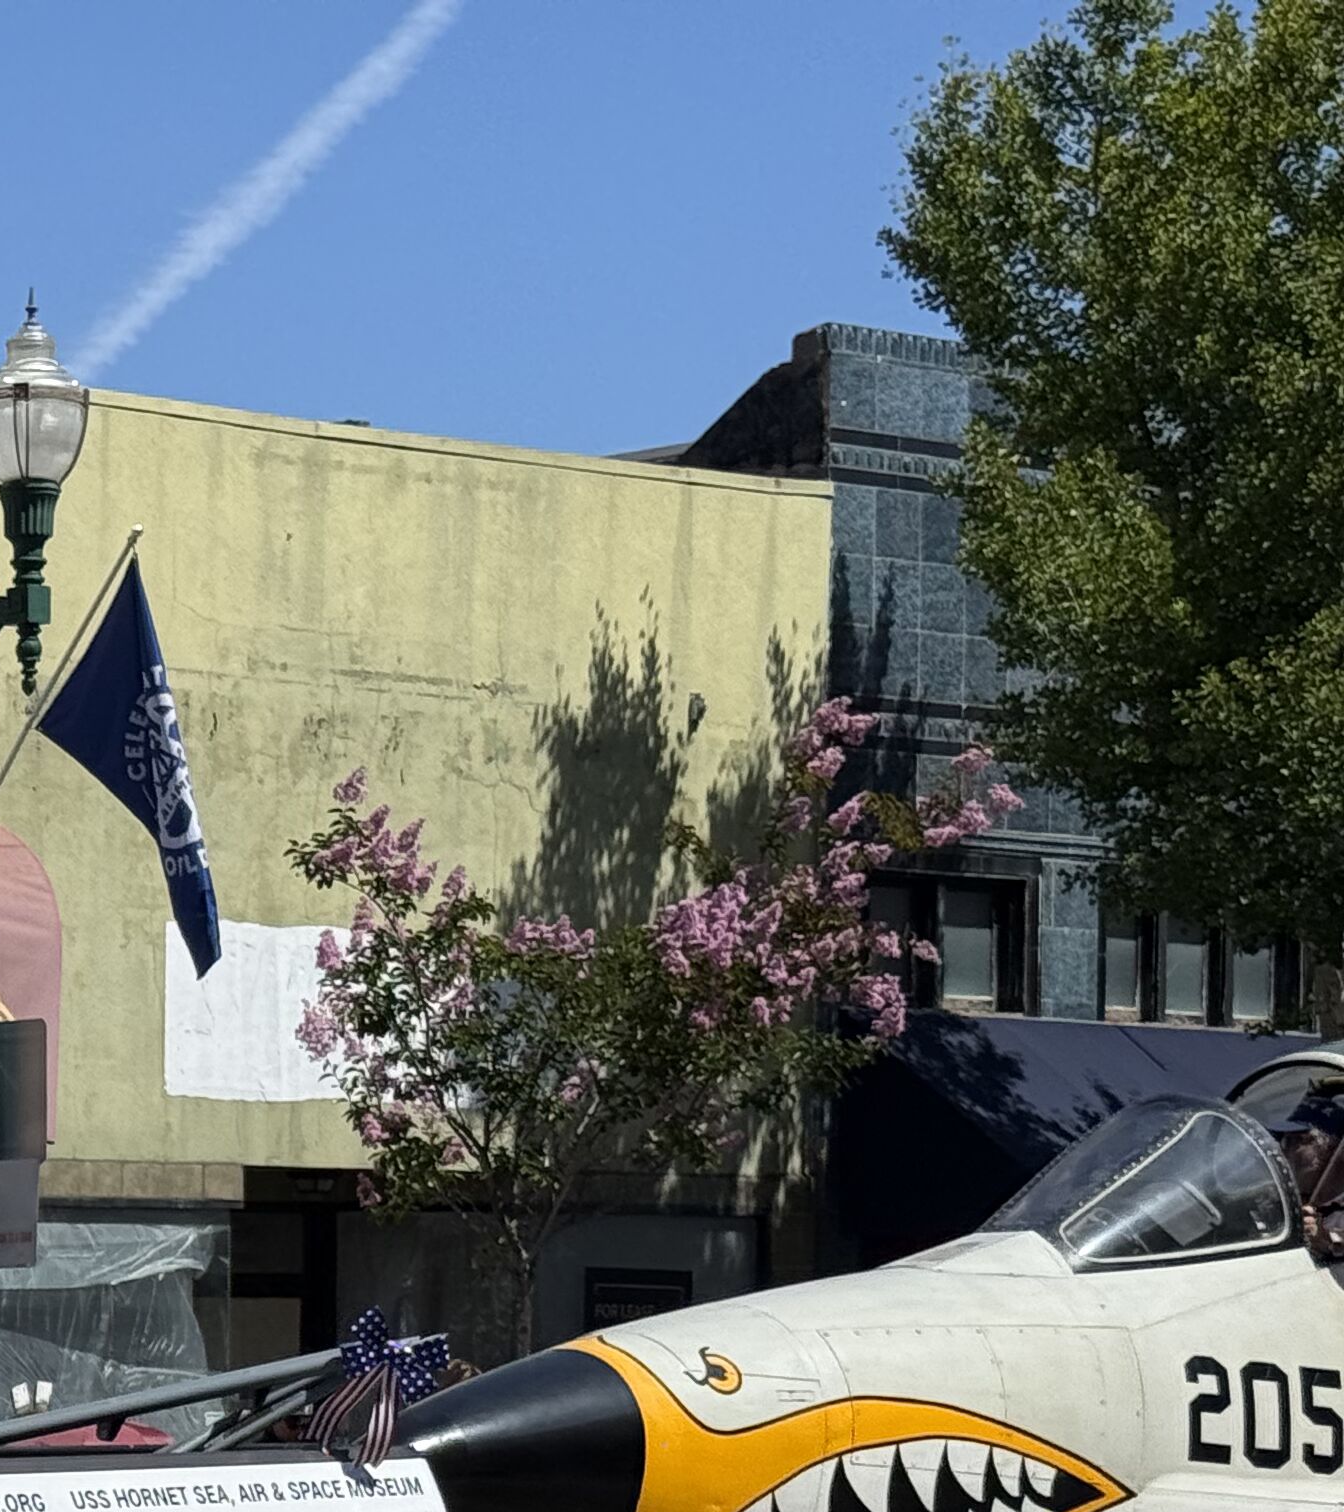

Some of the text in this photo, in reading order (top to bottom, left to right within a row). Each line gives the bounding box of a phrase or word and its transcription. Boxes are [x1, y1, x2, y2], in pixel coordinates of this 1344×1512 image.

[1184, 1355, 1344, 1475] 205
[69, 1488, 111, 1511] USS
[115, 1486, 190, 1508] HORNET
[195, 1482, 236, 1507] SEA,
[238, 1482, 268, 1504] AIR
[272, 1481, 285, 1502] &
[288, 1479, 342, 1502] SPACE
[346, 1475, 424, 1500] MUSEUM
